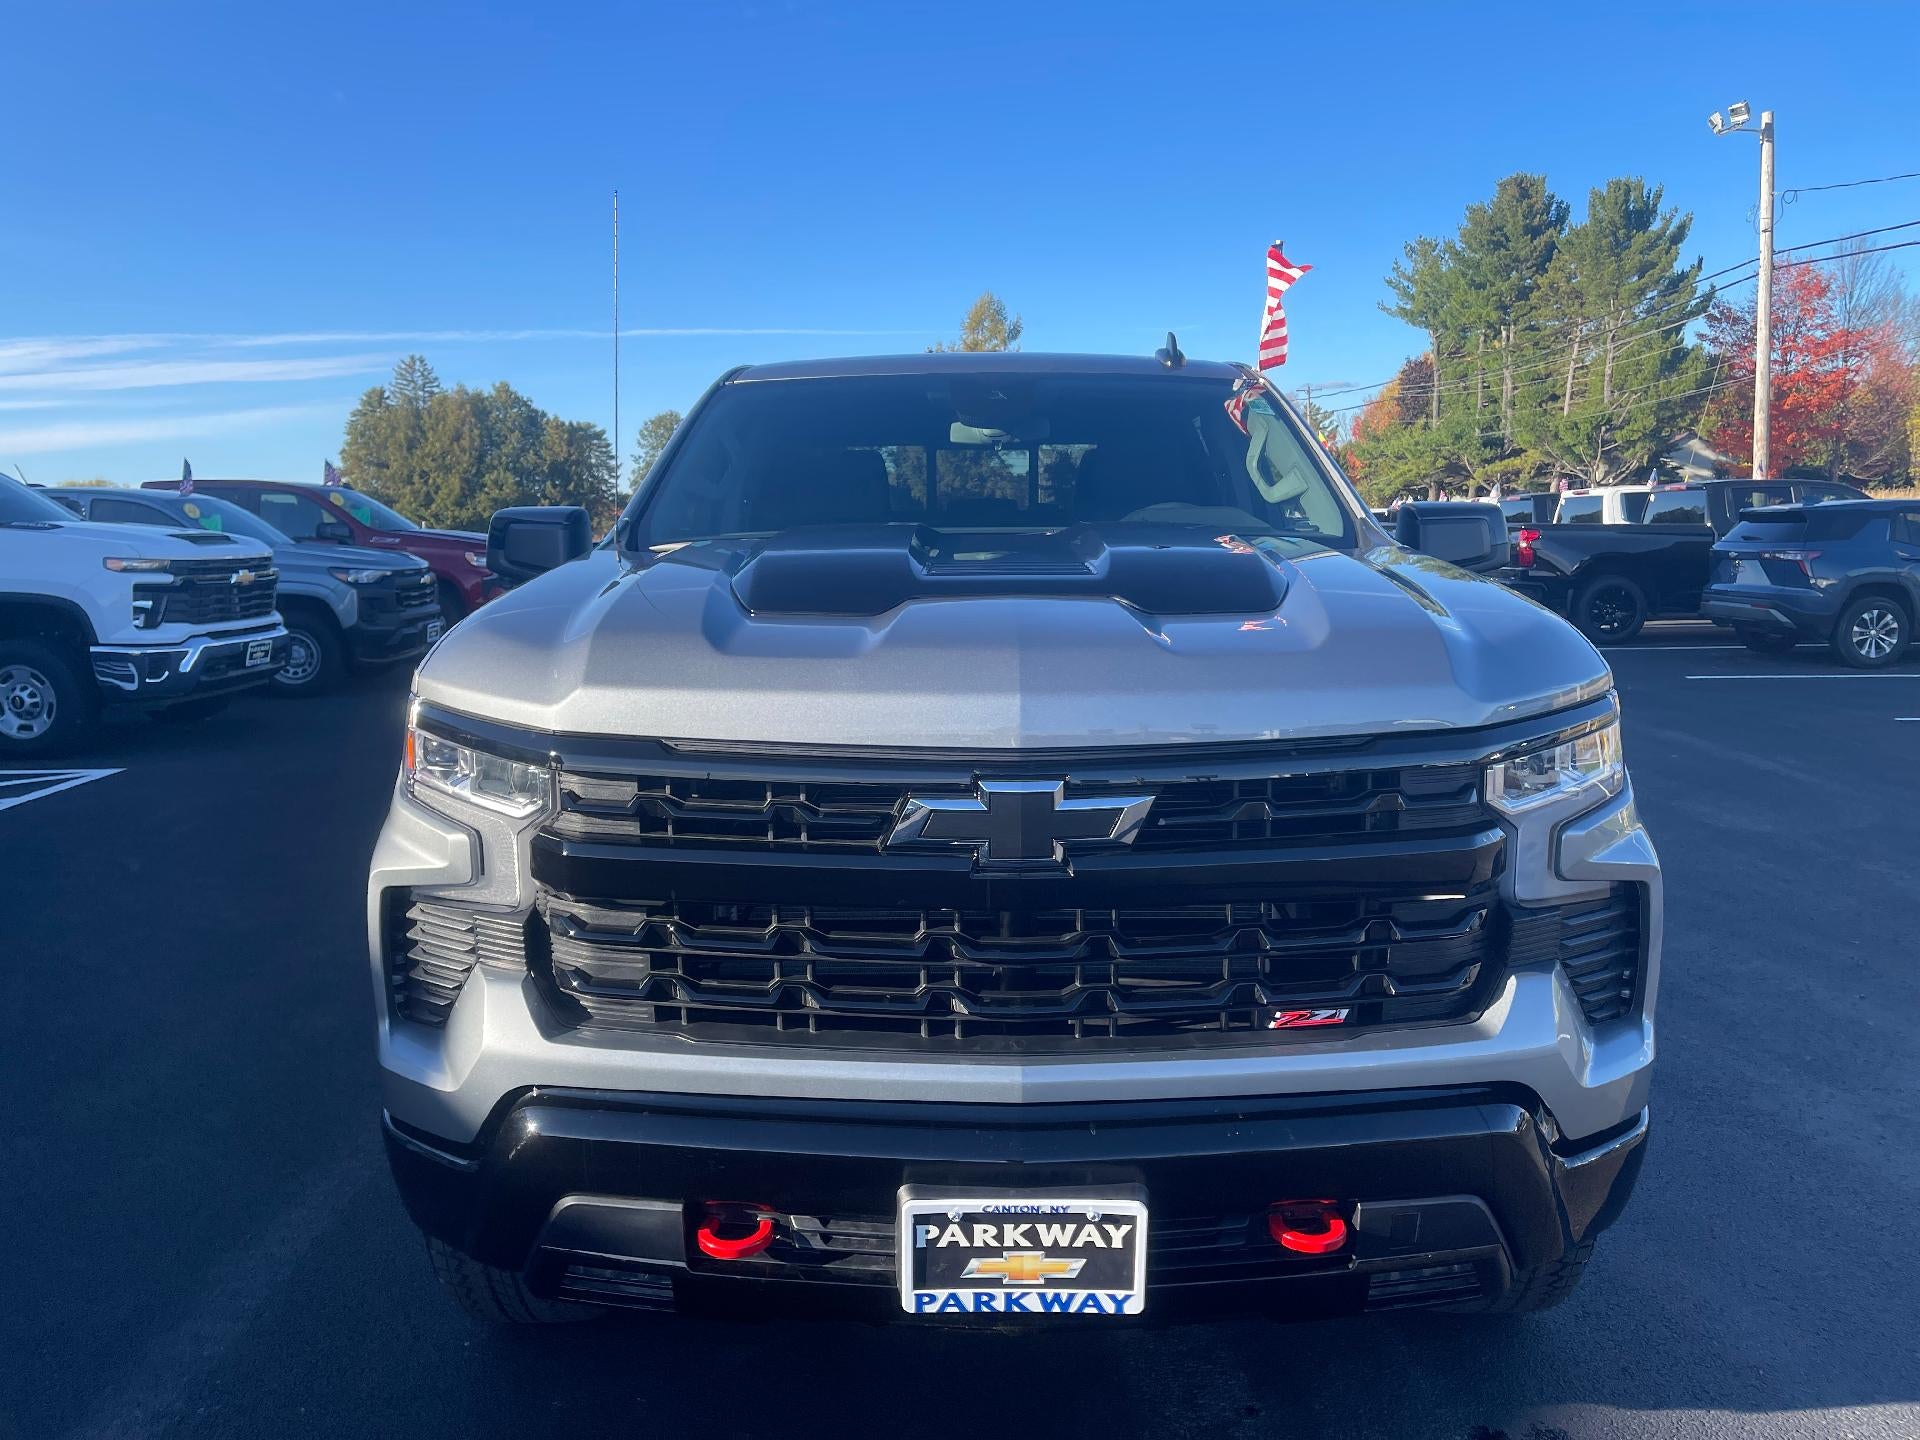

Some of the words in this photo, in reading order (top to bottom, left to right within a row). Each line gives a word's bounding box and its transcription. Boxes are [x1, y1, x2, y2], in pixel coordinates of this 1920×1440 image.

[1268, 1008, 1350, 1029] Z71
[1049, 1204, 1071, 1215] NY
[915, 1223, 1133, 1249] PARKWAY
[913, 1292, 1136, 1314] PARKWAY
